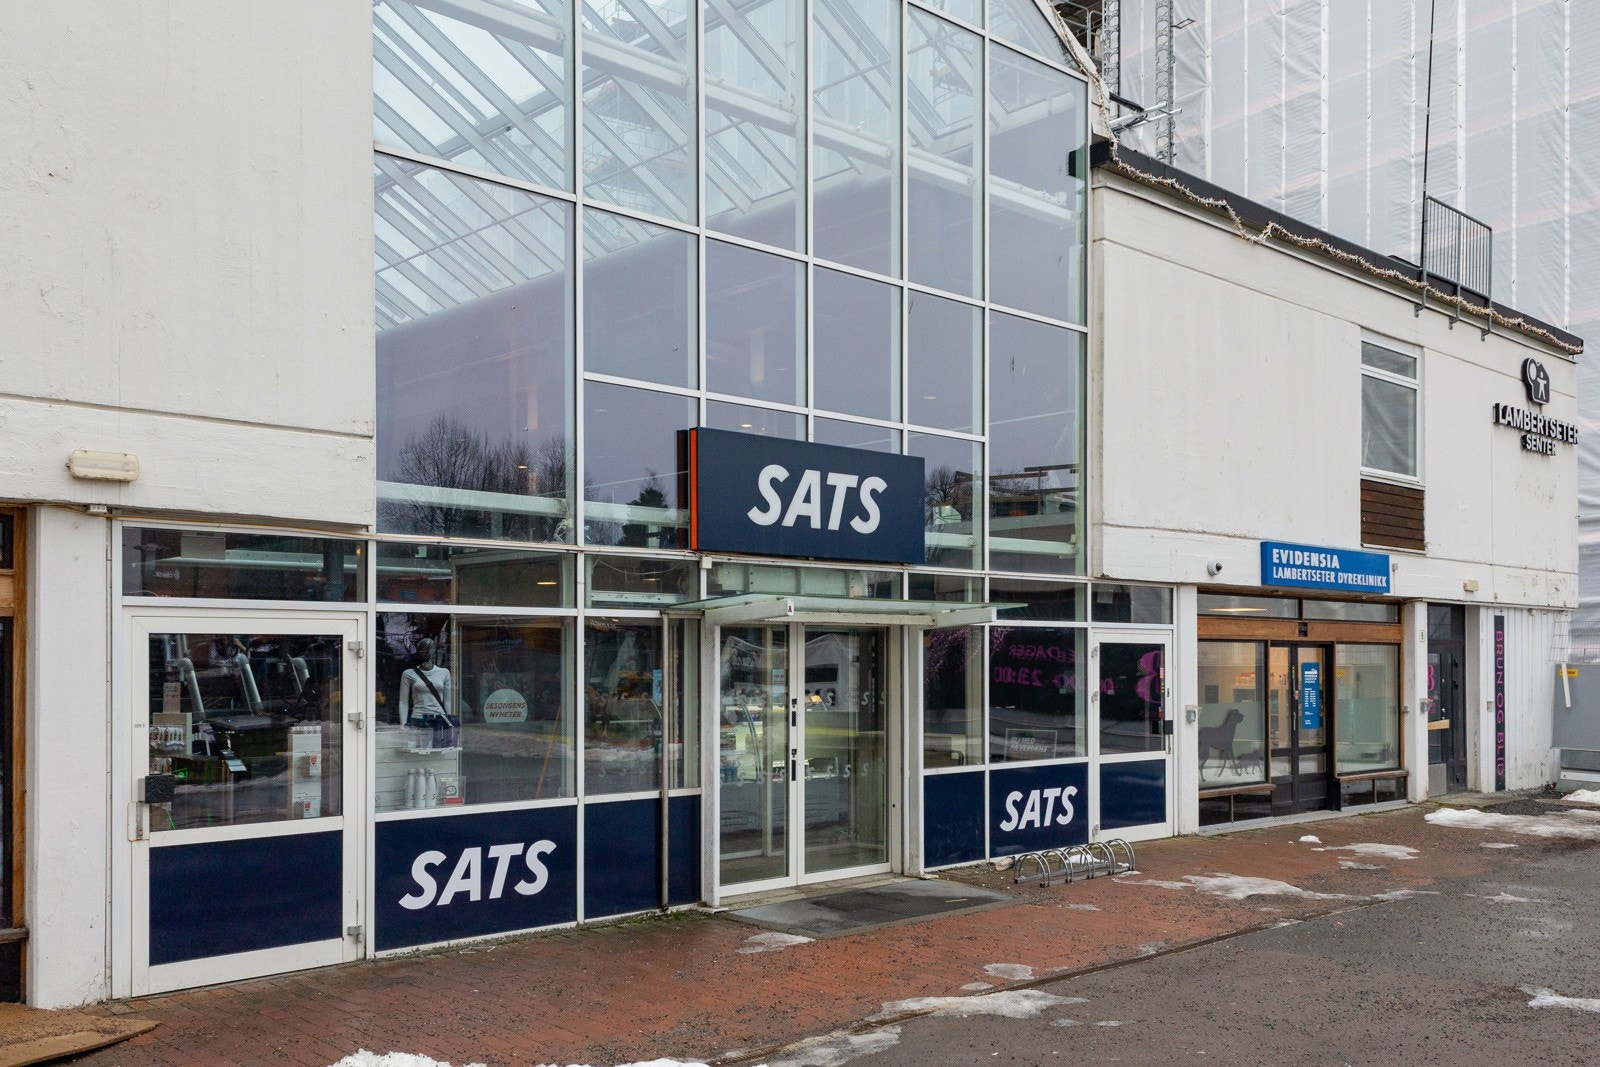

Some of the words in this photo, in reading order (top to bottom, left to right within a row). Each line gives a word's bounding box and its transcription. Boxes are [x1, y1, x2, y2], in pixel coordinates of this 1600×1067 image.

[1495, 403, 1579, 444] LAMBERTSETER
[1523, 433, 1557, 456] SENTER
[747, 464, 888, 534] SATS
[1272, 548, 1340, 569] EVIDENSIA
[1273, 566, 1336, 583] LAMBERTSETER
[1337, 572, 1388, 587] DYREKLINIKK
[1496, 630, 1504, 684] BRUN
[1496, 692, 1504, 724] OG
[1496, 732, 1504, 776] BLID
[999, 785, 1078, 832] SATS
[398, 839, 557, 910] SATS
